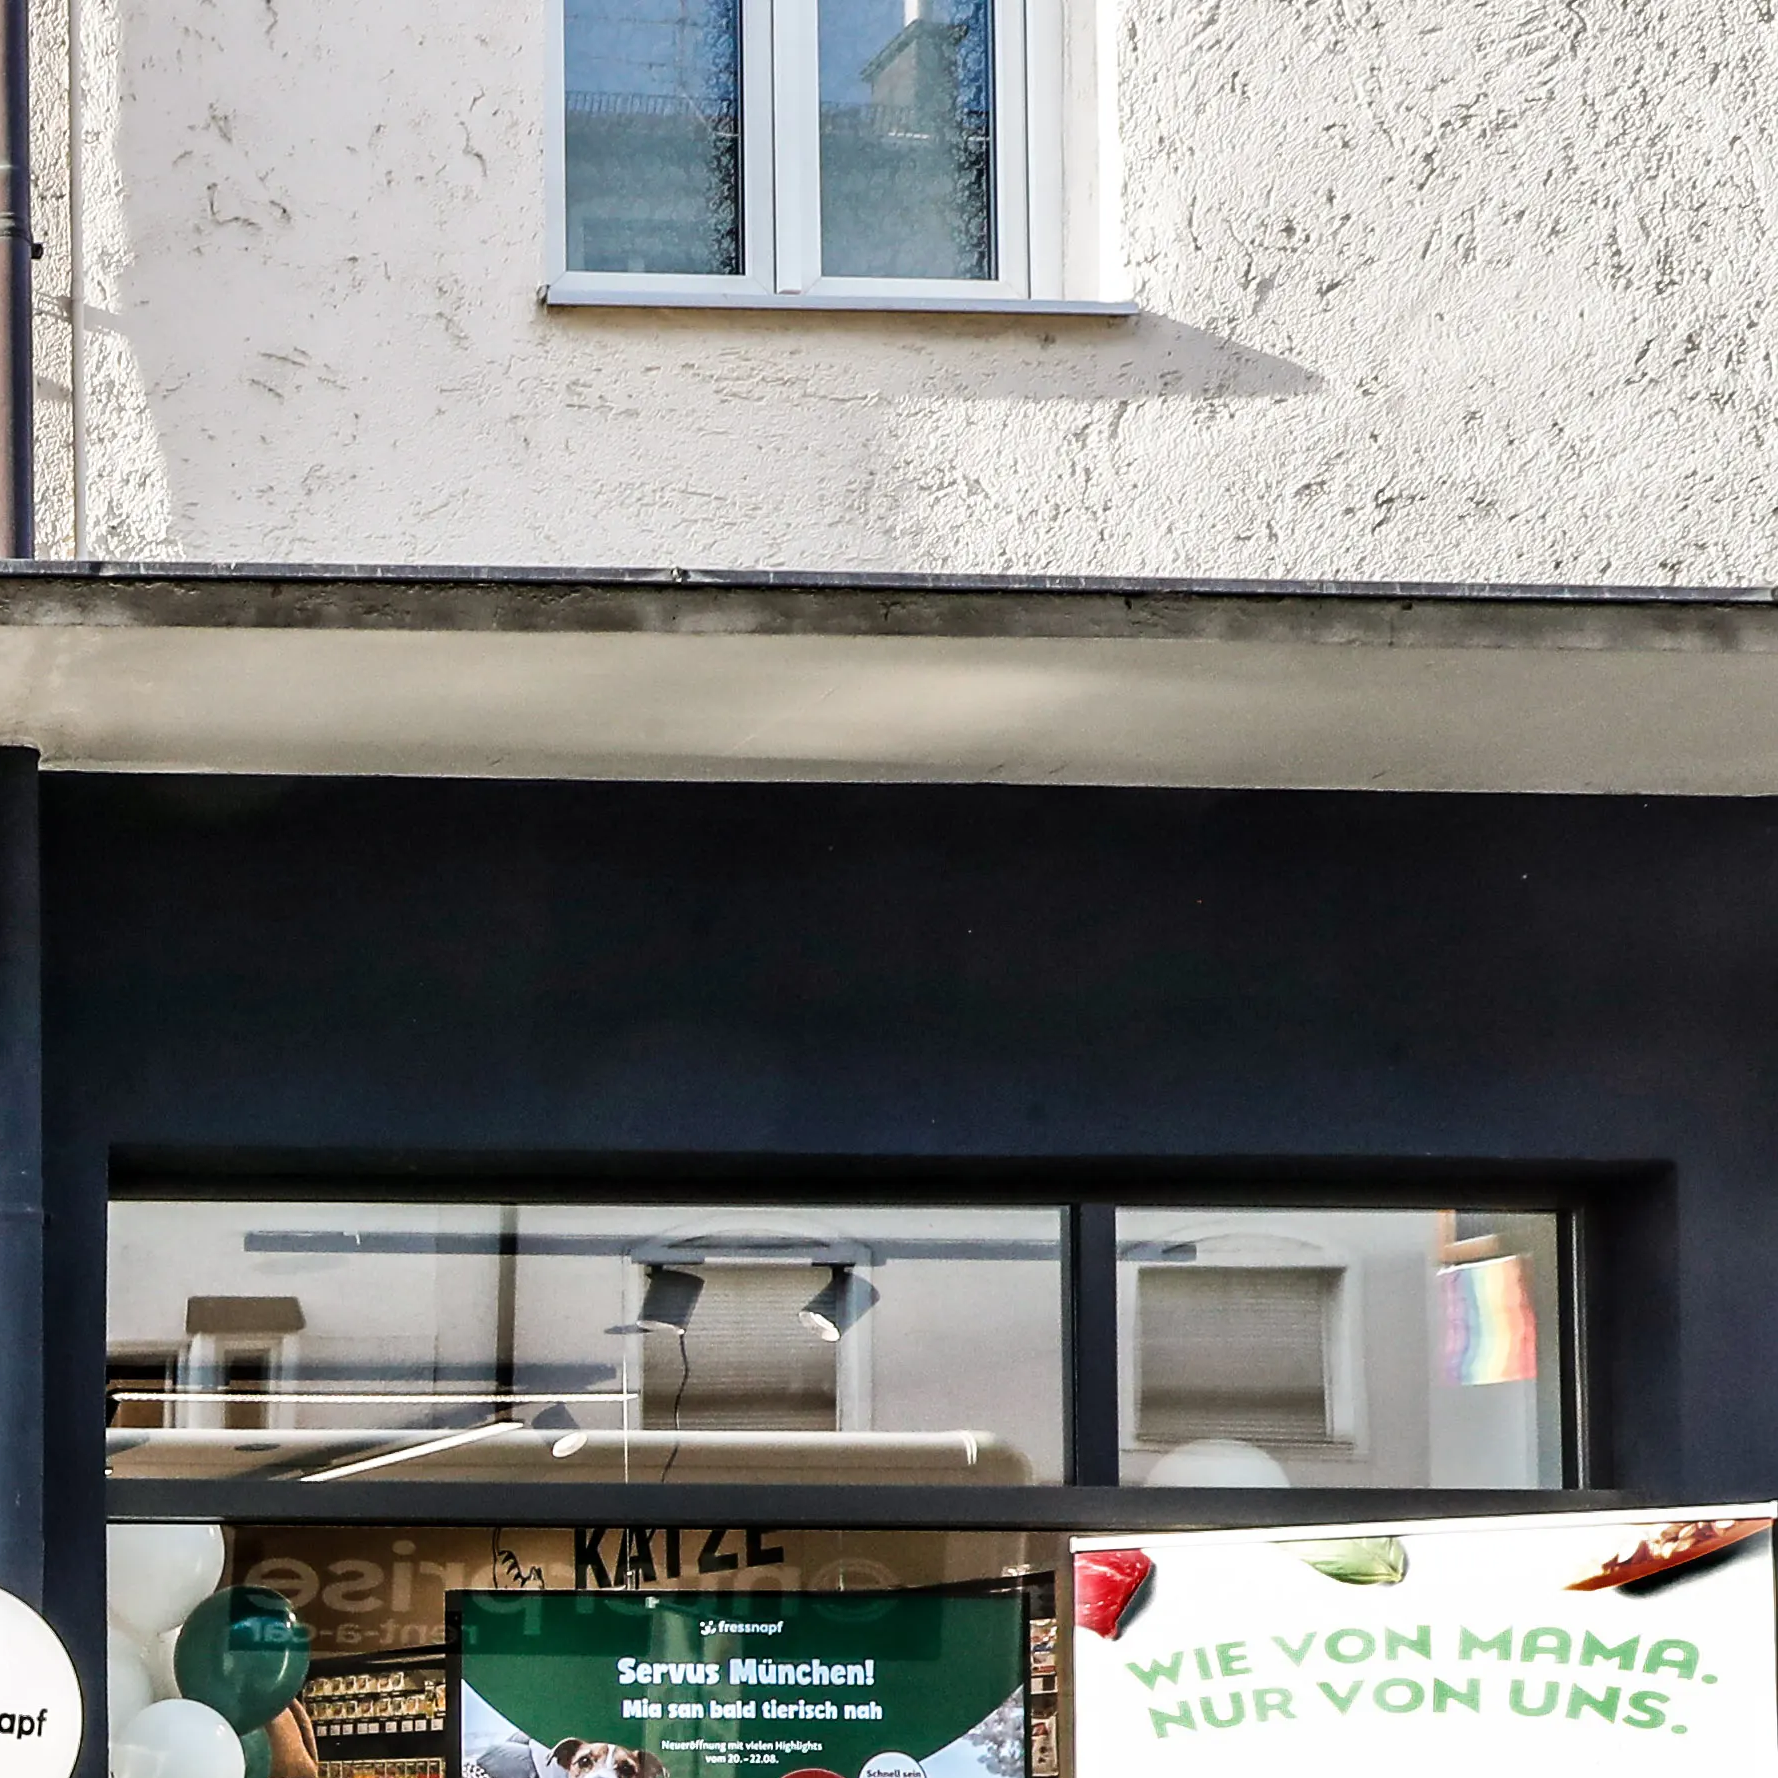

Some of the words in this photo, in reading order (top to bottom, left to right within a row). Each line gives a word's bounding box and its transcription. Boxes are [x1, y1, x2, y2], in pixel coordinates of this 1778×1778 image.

[718, 1621, 784, 1636] fressnapf
[1125, 1639, 1254, 1694] WIE
[1270, 1623, 1433, 1668] VON
[1457, 1625, 1719, 1686] MAMA.
[617, 1657, 720, 1686] Servus
[729, 1657, 875, 1686] München!
[622, 1698, 662, 1720] Mia
[667, 1702, 705, 1720] san
[709, 1699, 757, 1720] bald
[761, 1698, 838, 1720] tierisch
[844, 1700, 883, 1720] nah
[1147, 1686, 1298, 1740] NUR
[1316, 1677, 1481, 1718] VON
[1508, 1680, 1689, 1735] UNS.
[661, 1740, 726, 1752] Neueröffnung
[728, 1740, 744, 1750] mit
[745, 1740, 774, 1750] vielen
[775, 1740, 823, 1753] Highlights
[705, 1756, 726, 1764] vom
[866, 1769, 901, 1778] Schnell
